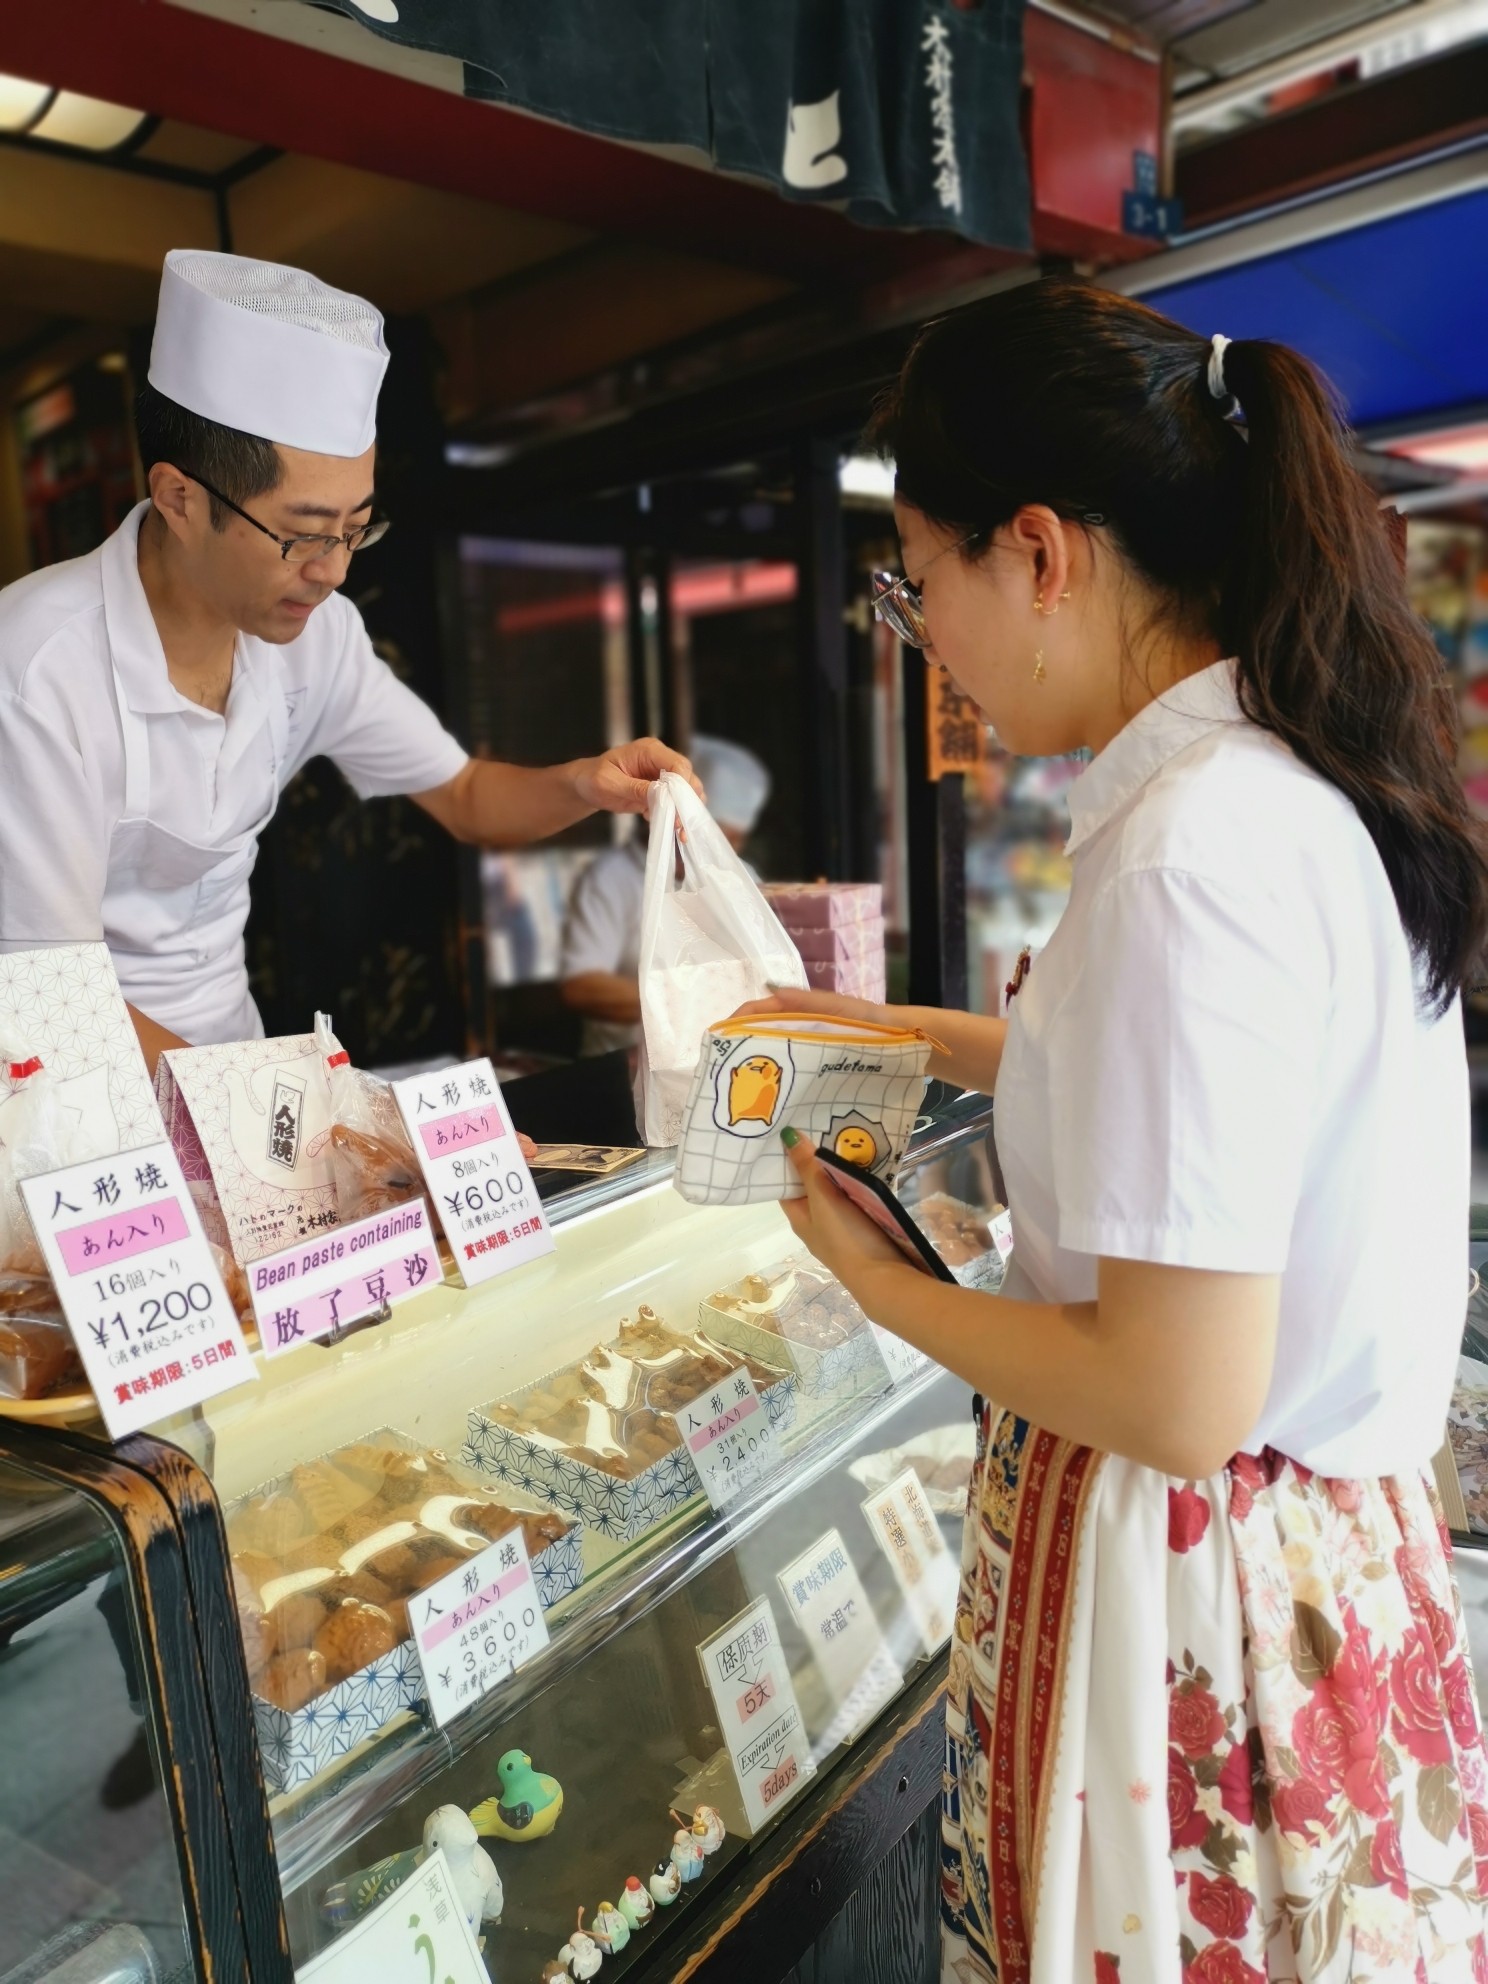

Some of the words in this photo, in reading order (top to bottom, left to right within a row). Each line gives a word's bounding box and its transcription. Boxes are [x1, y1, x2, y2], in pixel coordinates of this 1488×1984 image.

[820, 1057, 882, 1077] gudetama
[416, 1073, 492, 1115] 人形焼
[272, 1104, 296, 1163] 人形焼
[437, 1115, 490, 1146] あん入り
[452, 1151, 499, 1178] 8個入り
[51, 1162, 169, 1220] 人形焼
[443, 1171, 524, 1217] ¥600
[82, 1213, 166, 1257] あん入り
[239, 1204, 303, 1226] ハトのマークの
[307, 1210, 341, 1230] 木村家
[461, 1197, 530, 1232] (消費税込みです)
[255, 1260, 296, 1292] Bean
[302, 1240, 345, 1275] paste
[350, 1209, 423, 1254] containing
[463, 1216, 543, 1261] 賞味期限:5日間
[92, 1257, 181, 1302] 16個入り
[272, 1253, 428, 1346] 放了豆沙
[87, 1281, 213, 1350] ¥1,200
[107, 1315, 216, 1369] (消費税込みです)
[113, 1339, 237, 1405] 賞味期限:5日間
[688, 1378, 750, 1433] 人形焼
[708, 1407, 742, 1438] あん入り
[716, 1427, 748, 1454] 31個入り
[882, 1507, 922, 1584] 特選小
[424, 1543, 520, 1626] 人形焼
[792, 1547, 848, 1608] 賞味期限
[452, 1583, 500, 1629] あん入り
[820, 1598, 858, 1640] 常温で
[459, 1610, 504, 1648] 48個入り
[722, 1622, 768, 1673] 保质期
[744, 1679, 771, 1714] 5天
[741, 1724, 780, 1770] Expiration
[781, 1712, 797, 1735] date
[763, 1761, 798, 1803] 5days
[423, 1873, 450, 1925] 浅草
